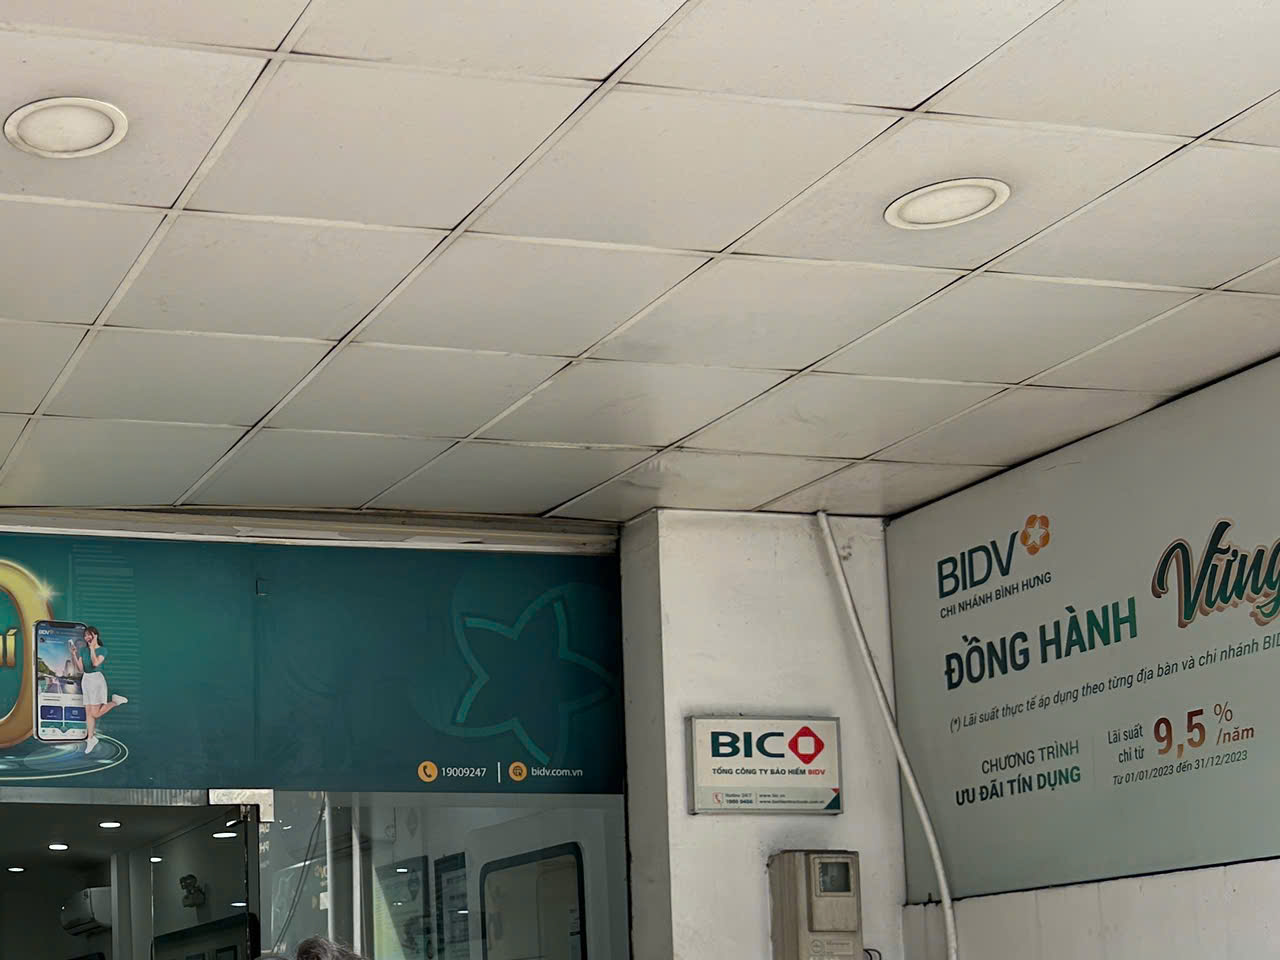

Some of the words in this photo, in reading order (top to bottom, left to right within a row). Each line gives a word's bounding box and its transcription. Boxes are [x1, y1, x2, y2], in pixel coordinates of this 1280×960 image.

[937, 530, 1019, 599] BIDV
[940, 606, 956, 619] CHI
[958, 591, 993, 613] NHÁNH
[995, 582, 1020, 605] BÌNH
[1021, 571, 1052, 597] HƯNG
[944, 631, 1030, 691] ĐỒNG
[1039, 596, 1138, 664] HÀNH
[1001, 700, 1024, 720] thực
[1053, 688, 1079, 708] dụng
[1081, 681, 1106, 697] theo
[1108, 674, 1134, 693] từng
[1136, 667, 1154, 686] địa
[1156, 660, 1179, 678] bàn
[1181, 655, 1196, 672] và
[1198, 649, 1218, 667] chi
[1219, 639, 1260, 662] nhánh
[710, 731, 785, 758] BIC
[1108, 729, 1122, 745] Lãi
[1122, 723, 1144, 742] suất
[1154, 708, 1207, 759] 9,5
[1214, 701, 1233, 724] %
[1215, 723, 1255, 746] /năm
[441, 766, 487, 778] 19009247
[531, 766, 583, 778] bidv.com.vn
[712, 765, 733, 775] TỔNG
[735, 766, 757, 775] CÔNG
[981, 748, 1036, 774] CHƯƠNG
[1038, 740, 1080, 762] TRÌNH
[1124, 764, 1175, 786] 01/01/2023
[1194, 749, 1249, 771] 31/12/2023
[955, 788, 976, 806] ƯU
[979, 779, 1005, 803] ĐÃI
[1006, 771, 1033, 796] TÍN
[1037, 765, 1081, 792] DỤNG
